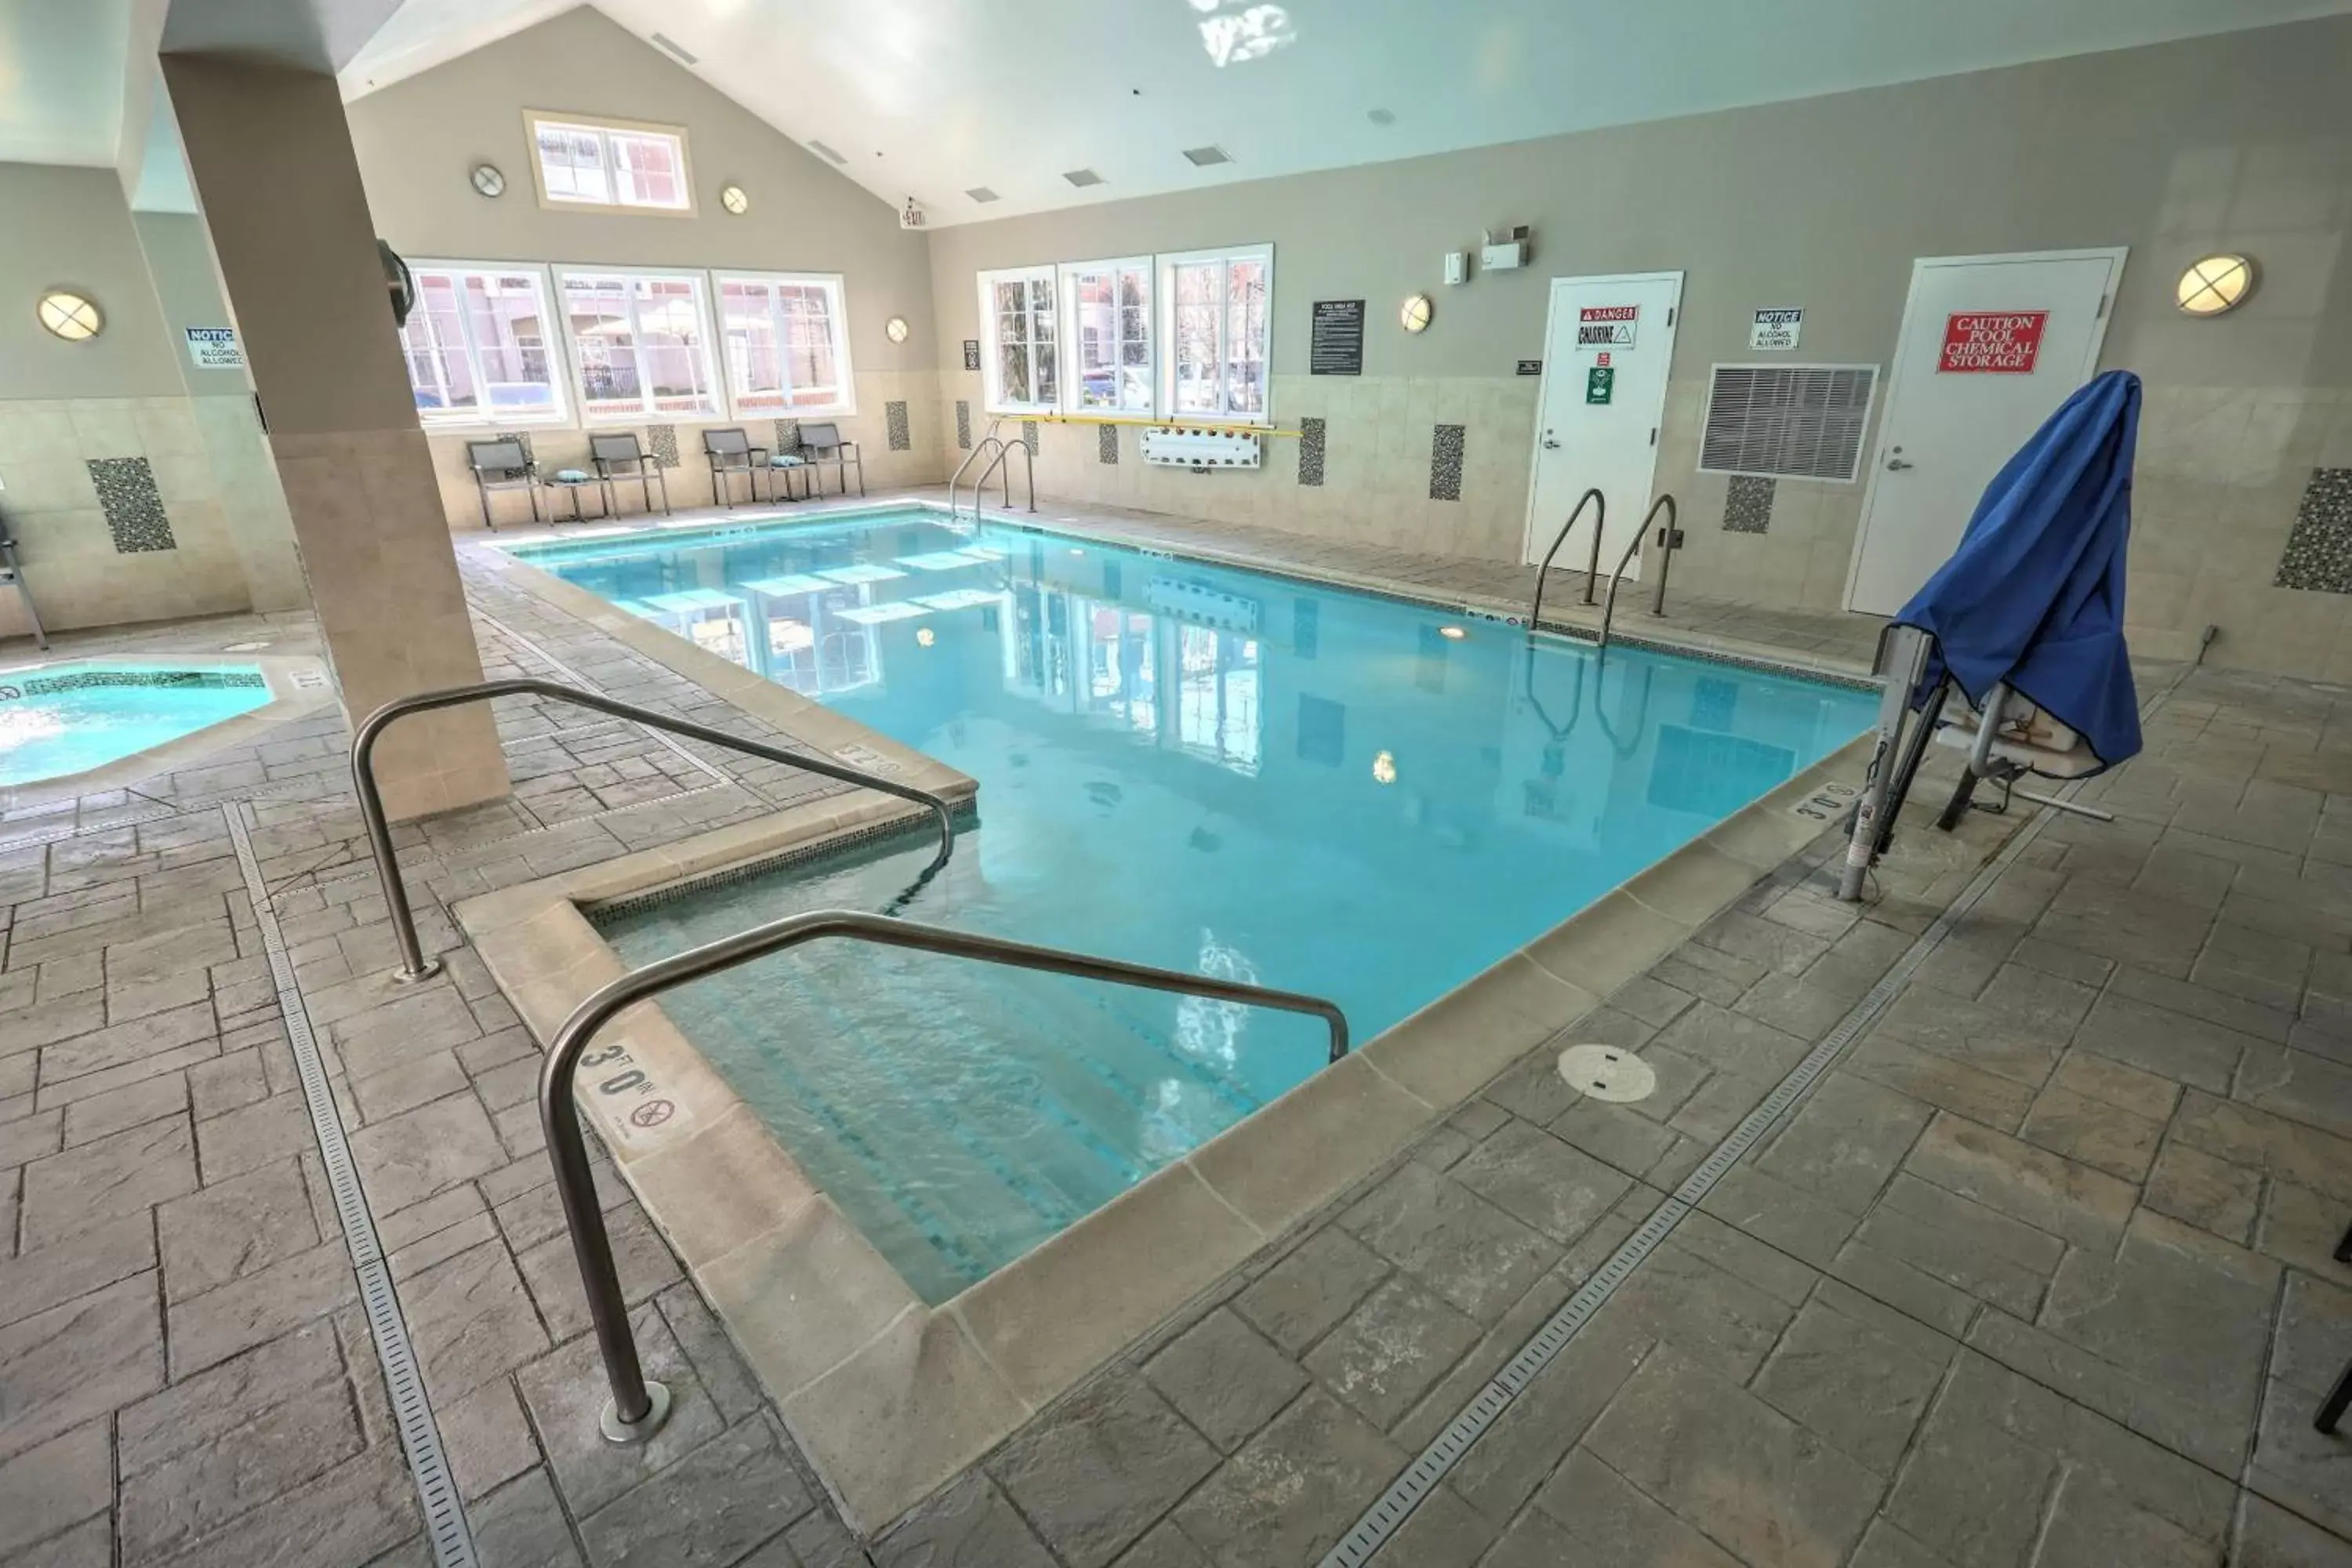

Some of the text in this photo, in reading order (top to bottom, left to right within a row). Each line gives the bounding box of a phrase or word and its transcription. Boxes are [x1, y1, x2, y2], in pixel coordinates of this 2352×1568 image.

[1595, 308, 1634, 319] DANGER
[1758, 311, 1799, 322] NOTICE
[1956, 316, 2035, 330] CAUTION
[1969, 328, 2015, 343] POOL
[1946, 339, 2034, 355] CHEMICAL
[1947, 353, 2025, 368] STORAGE
[579, 1045, 625, 1067] 3
[599, 1069, 645, 1095] 0
